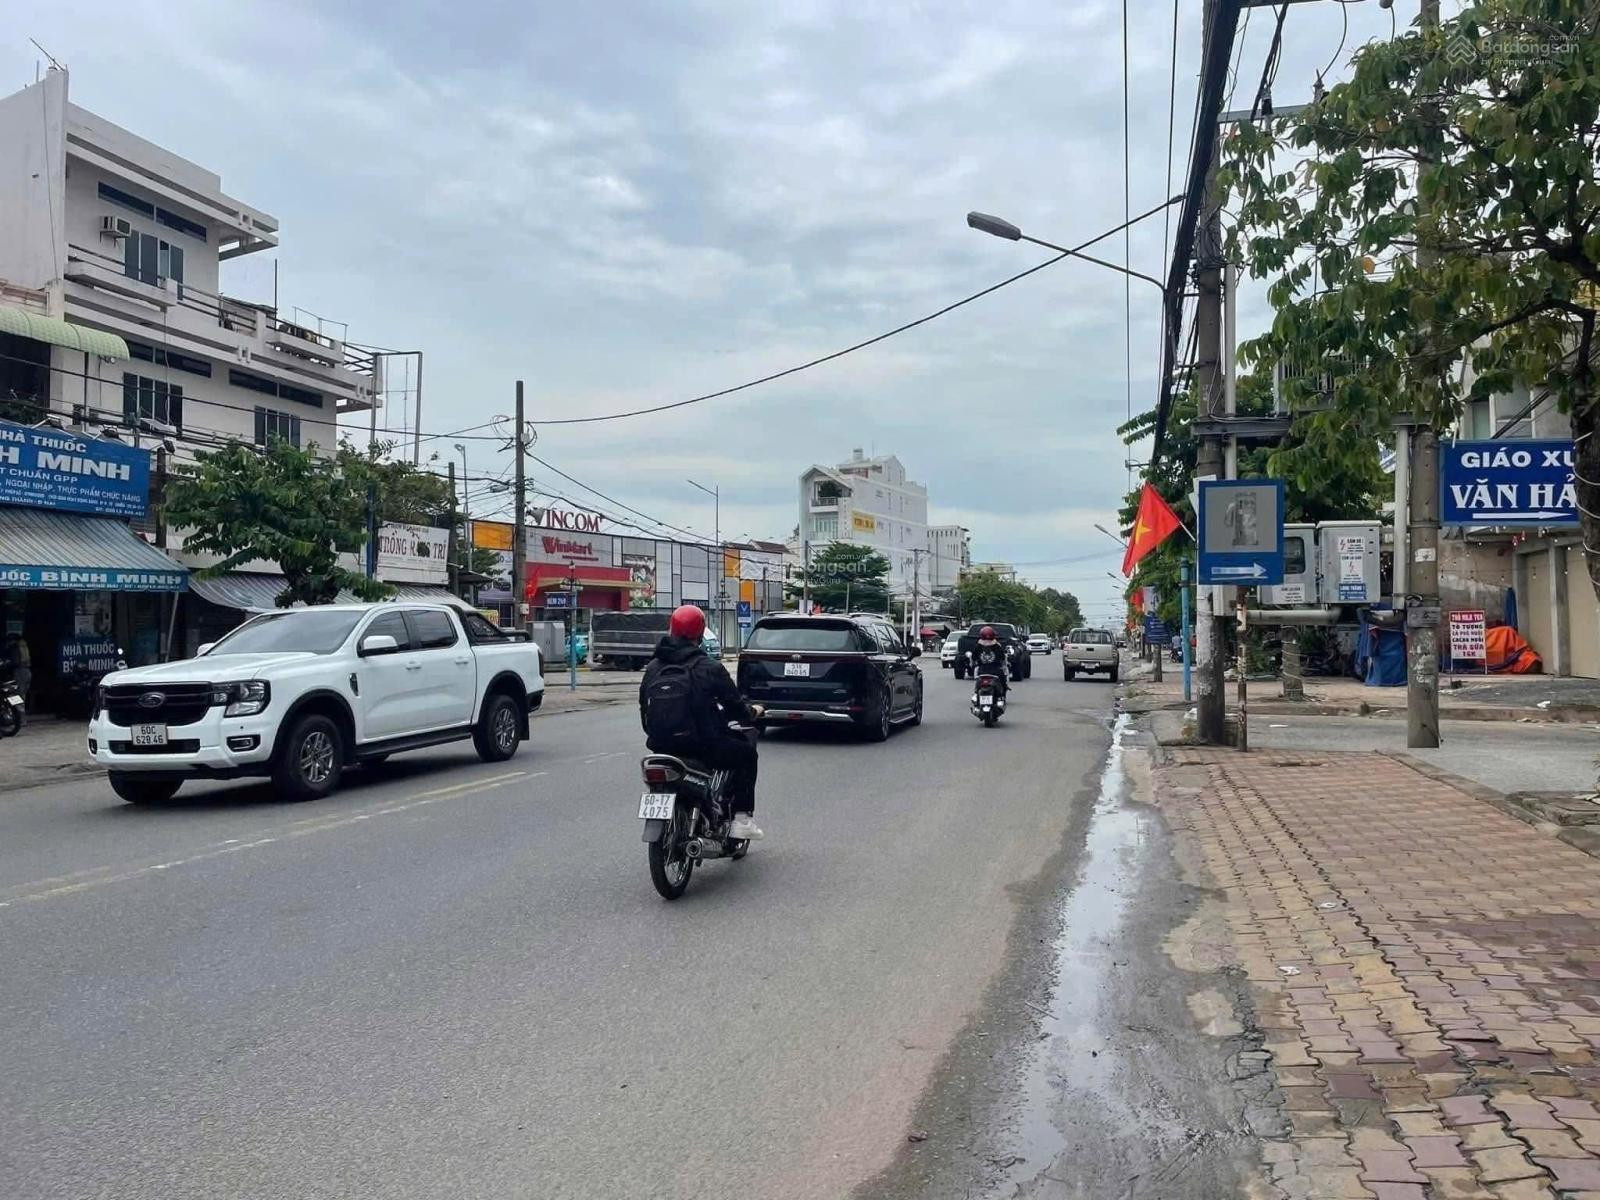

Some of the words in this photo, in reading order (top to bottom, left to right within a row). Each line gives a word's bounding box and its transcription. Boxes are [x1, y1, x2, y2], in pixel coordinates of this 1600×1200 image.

[31, 437, 87, 453] THUỐC
[37, 450, 130, 480] MINH
[1461, 447, 1532, 468] GIÁO
[9, 468, 51, 480] CHUẨN
[53, 474, 78, 483] GPP
[1450, 479, 1518, 508] VĂN
[542, 536, 592, 555] WinMart
[41, 571, 107, 583] BÌNH
[117, 574, 182, 584] MINH
[83, 639, 115, 655] THUỐC
[88, 658, 115, 671] MINH
[141, 726, 156, 735] 60C
[644, 795, 671, 806] 60-17
[642, 806, 669, 818] 4075
